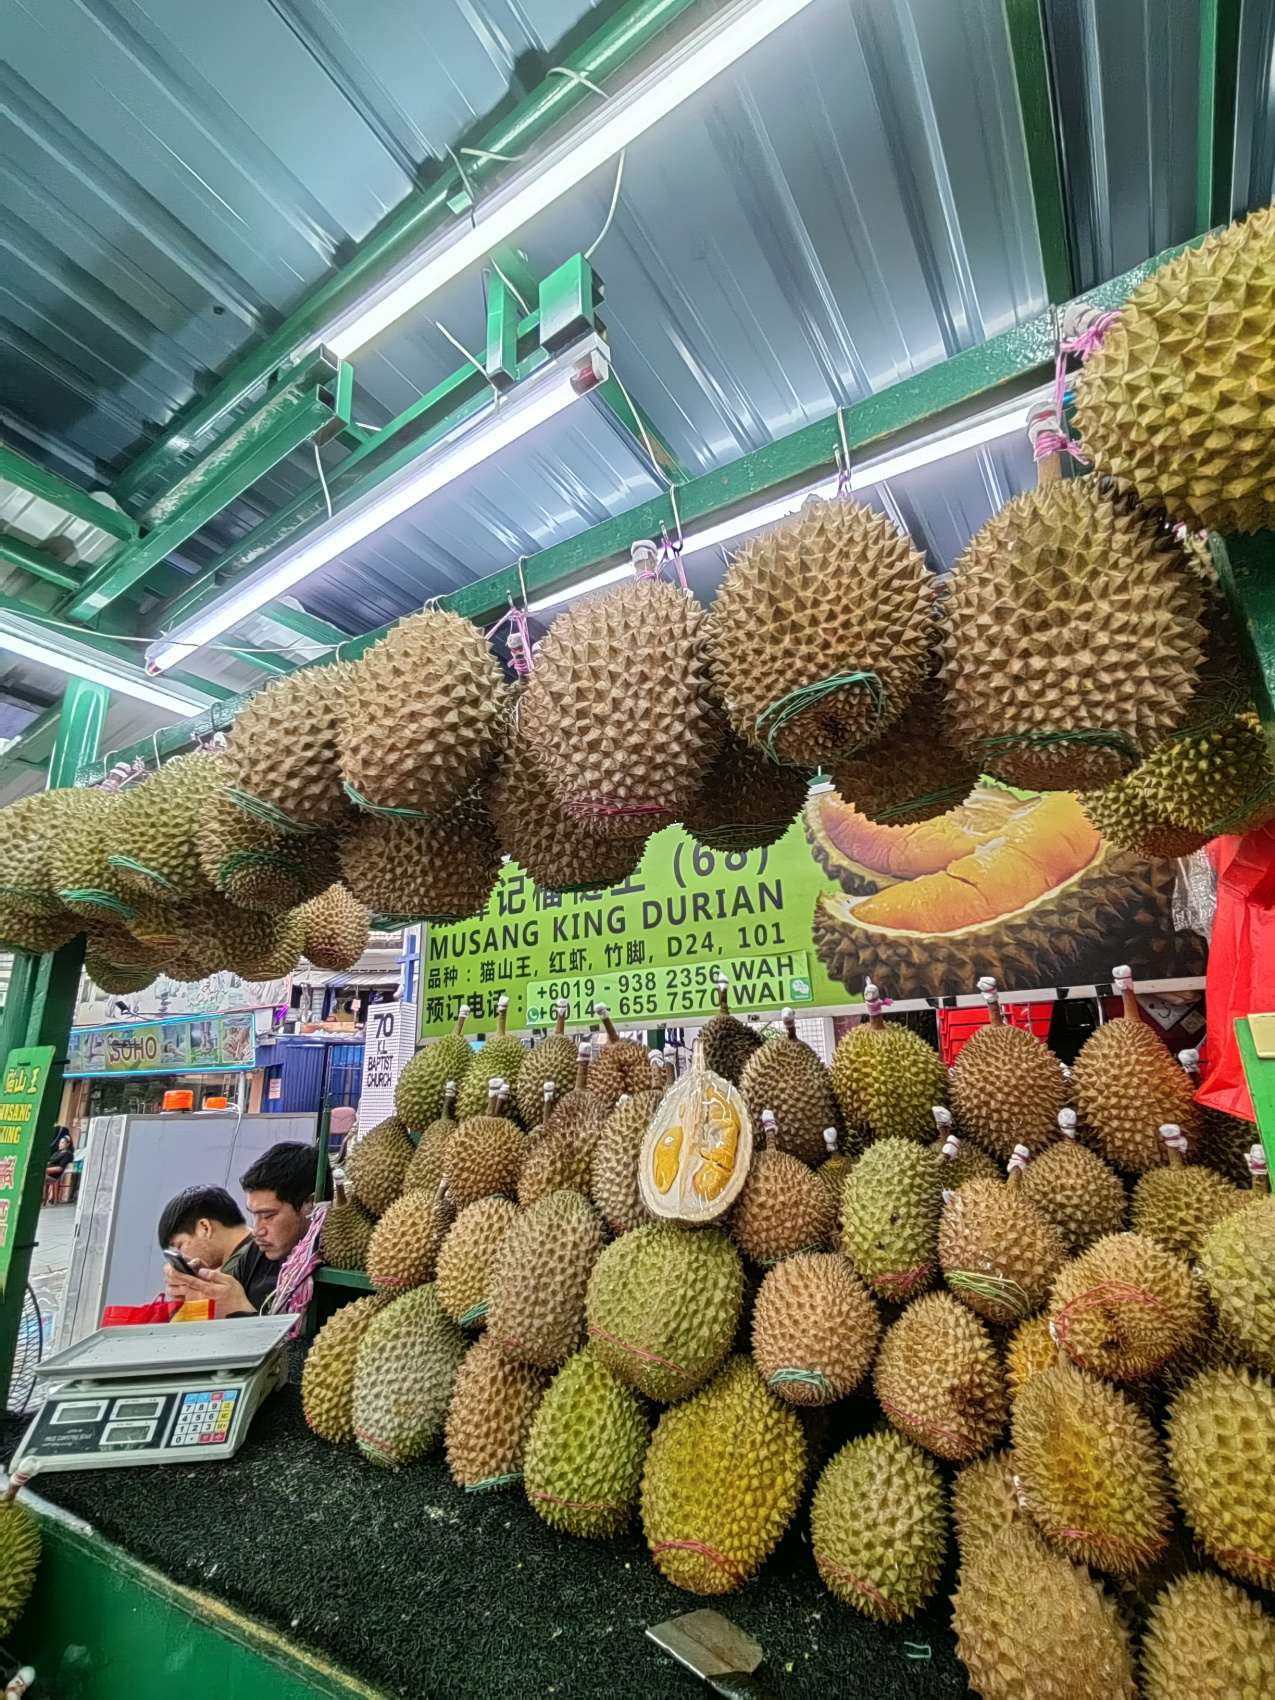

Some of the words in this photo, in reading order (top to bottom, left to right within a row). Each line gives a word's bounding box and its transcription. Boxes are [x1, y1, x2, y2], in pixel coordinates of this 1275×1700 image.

[430, 920, 539, 961] MUSANG
[553, 905, 626, 943] KING
[642, 879, 784, 930] DURIAN
[738, 922, 785, 949] 101
[618, 972, 657, 994] 938
[666, 964, 722, 989] 2356
[731, 955, 795, 982] WAH
[619, 993, 658, 1015] 655
[733, 980, 786, 1005] WAI
[373, 1012, 394, 1038] 70
[109, 1035, 158, 1063] SOHO
[367, 1055, 393, 1071] BAPTIST
[367, 1072, 392, 1088] CHURCH
